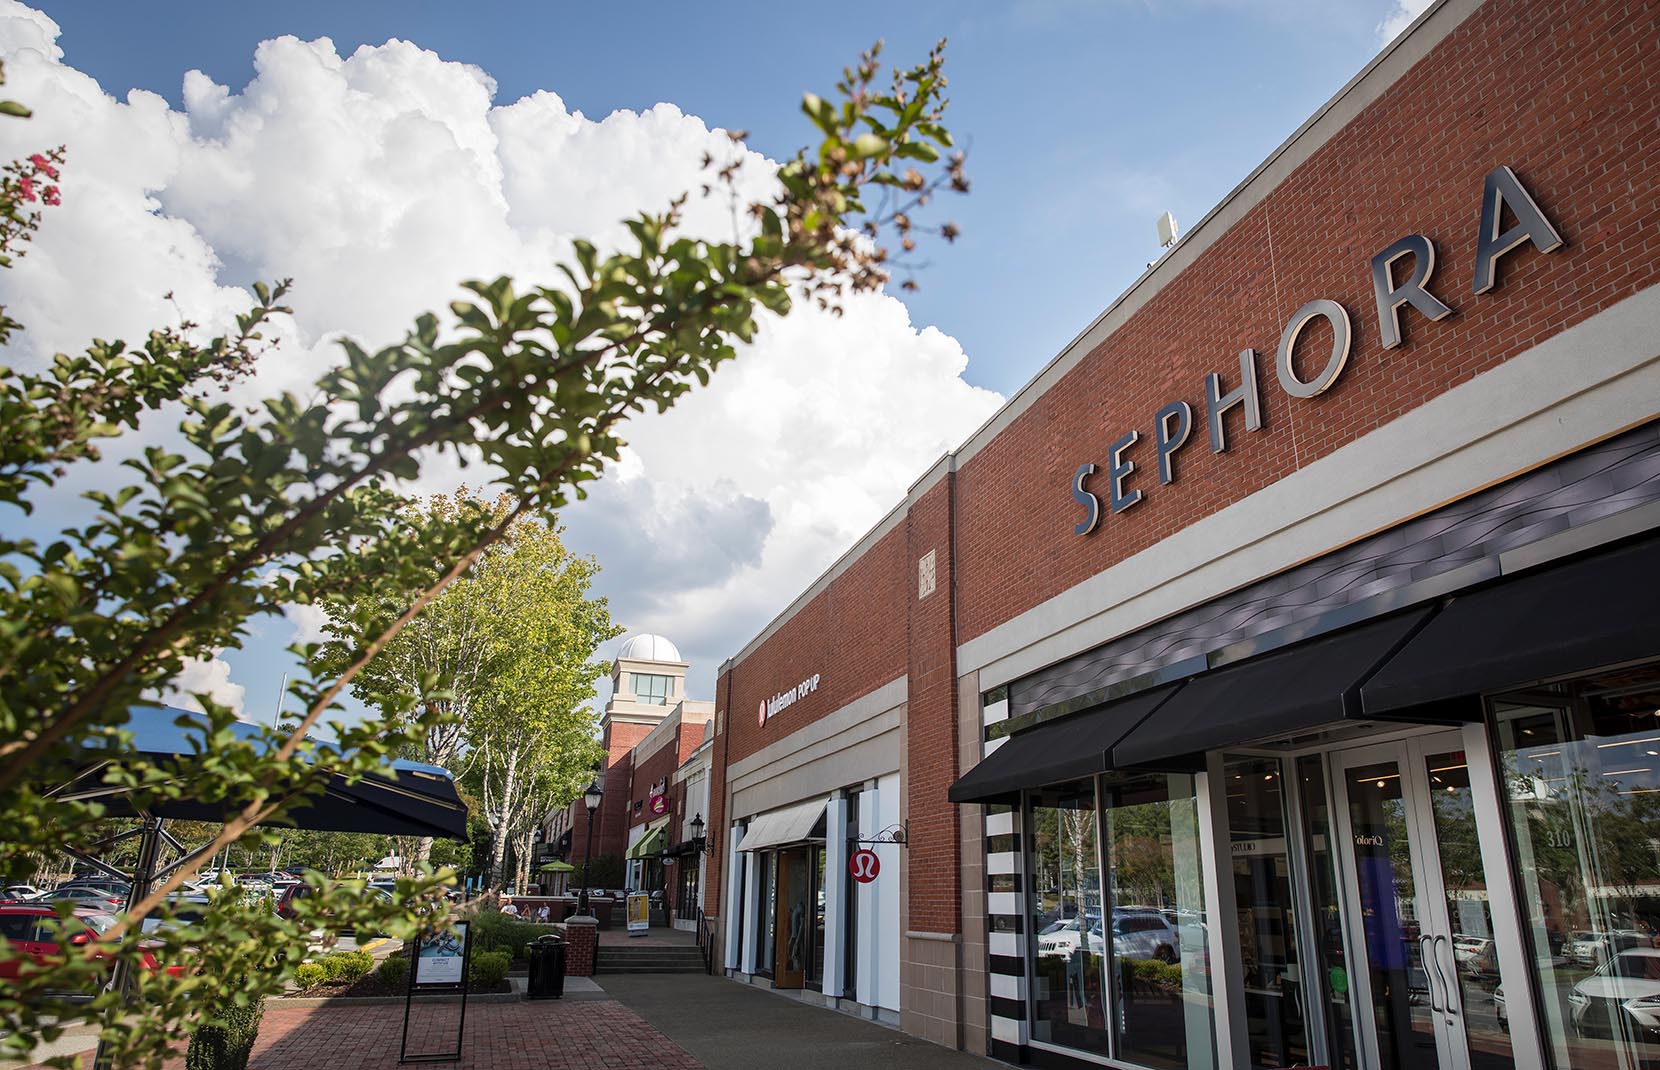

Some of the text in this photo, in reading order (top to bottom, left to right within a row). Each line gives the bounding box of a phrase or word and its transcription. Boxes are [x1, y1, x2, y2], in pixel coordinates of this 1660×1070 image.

[1072, 164, 1565, 537] SEPHORA
[766, 674, 820, 719] lululemon POP UP
[1546, 830, 1570, 847] 310
